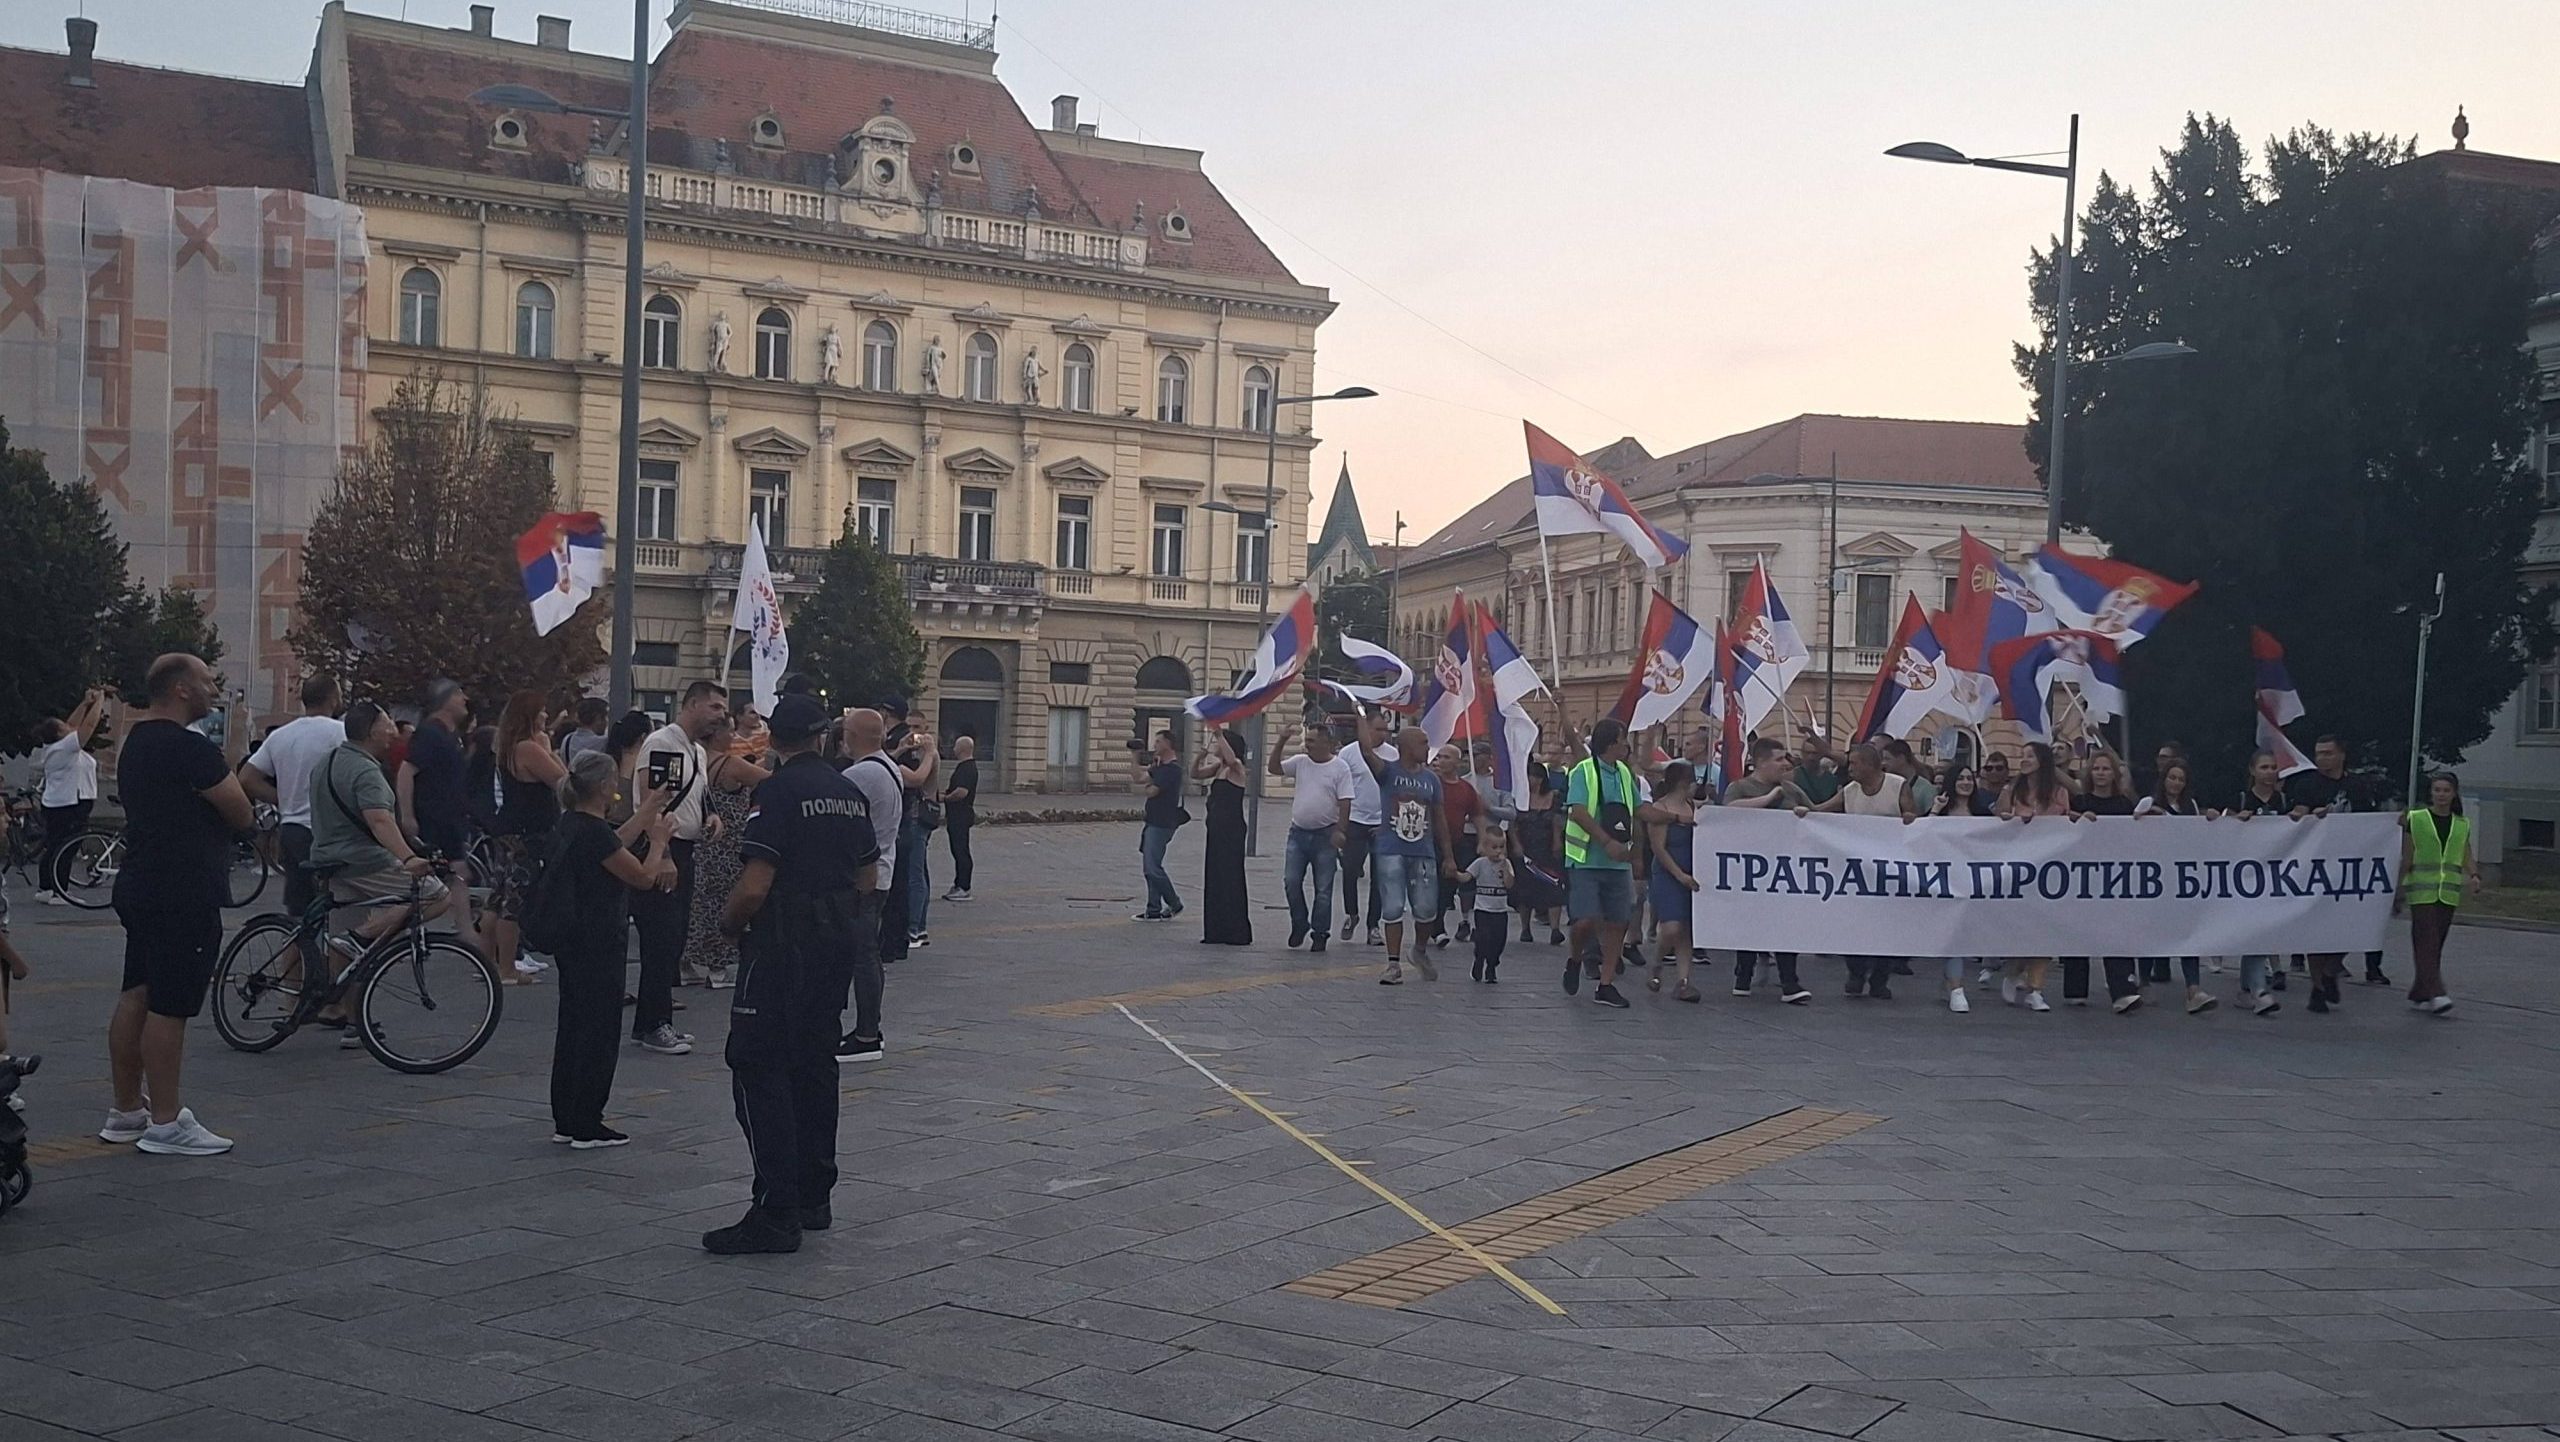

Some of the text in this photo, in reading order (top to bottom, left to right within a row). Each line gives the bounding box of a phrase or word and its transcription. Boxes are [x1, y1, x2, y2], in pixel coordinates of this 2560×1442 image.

[172, 388, 251, 622] RÖFI
[801, 798, 867, 819] ПОЛИЦИЈ
[1715, 852, 2393, 902] ГРАЂАНИ ПРОТИВ БЛОКАДА
